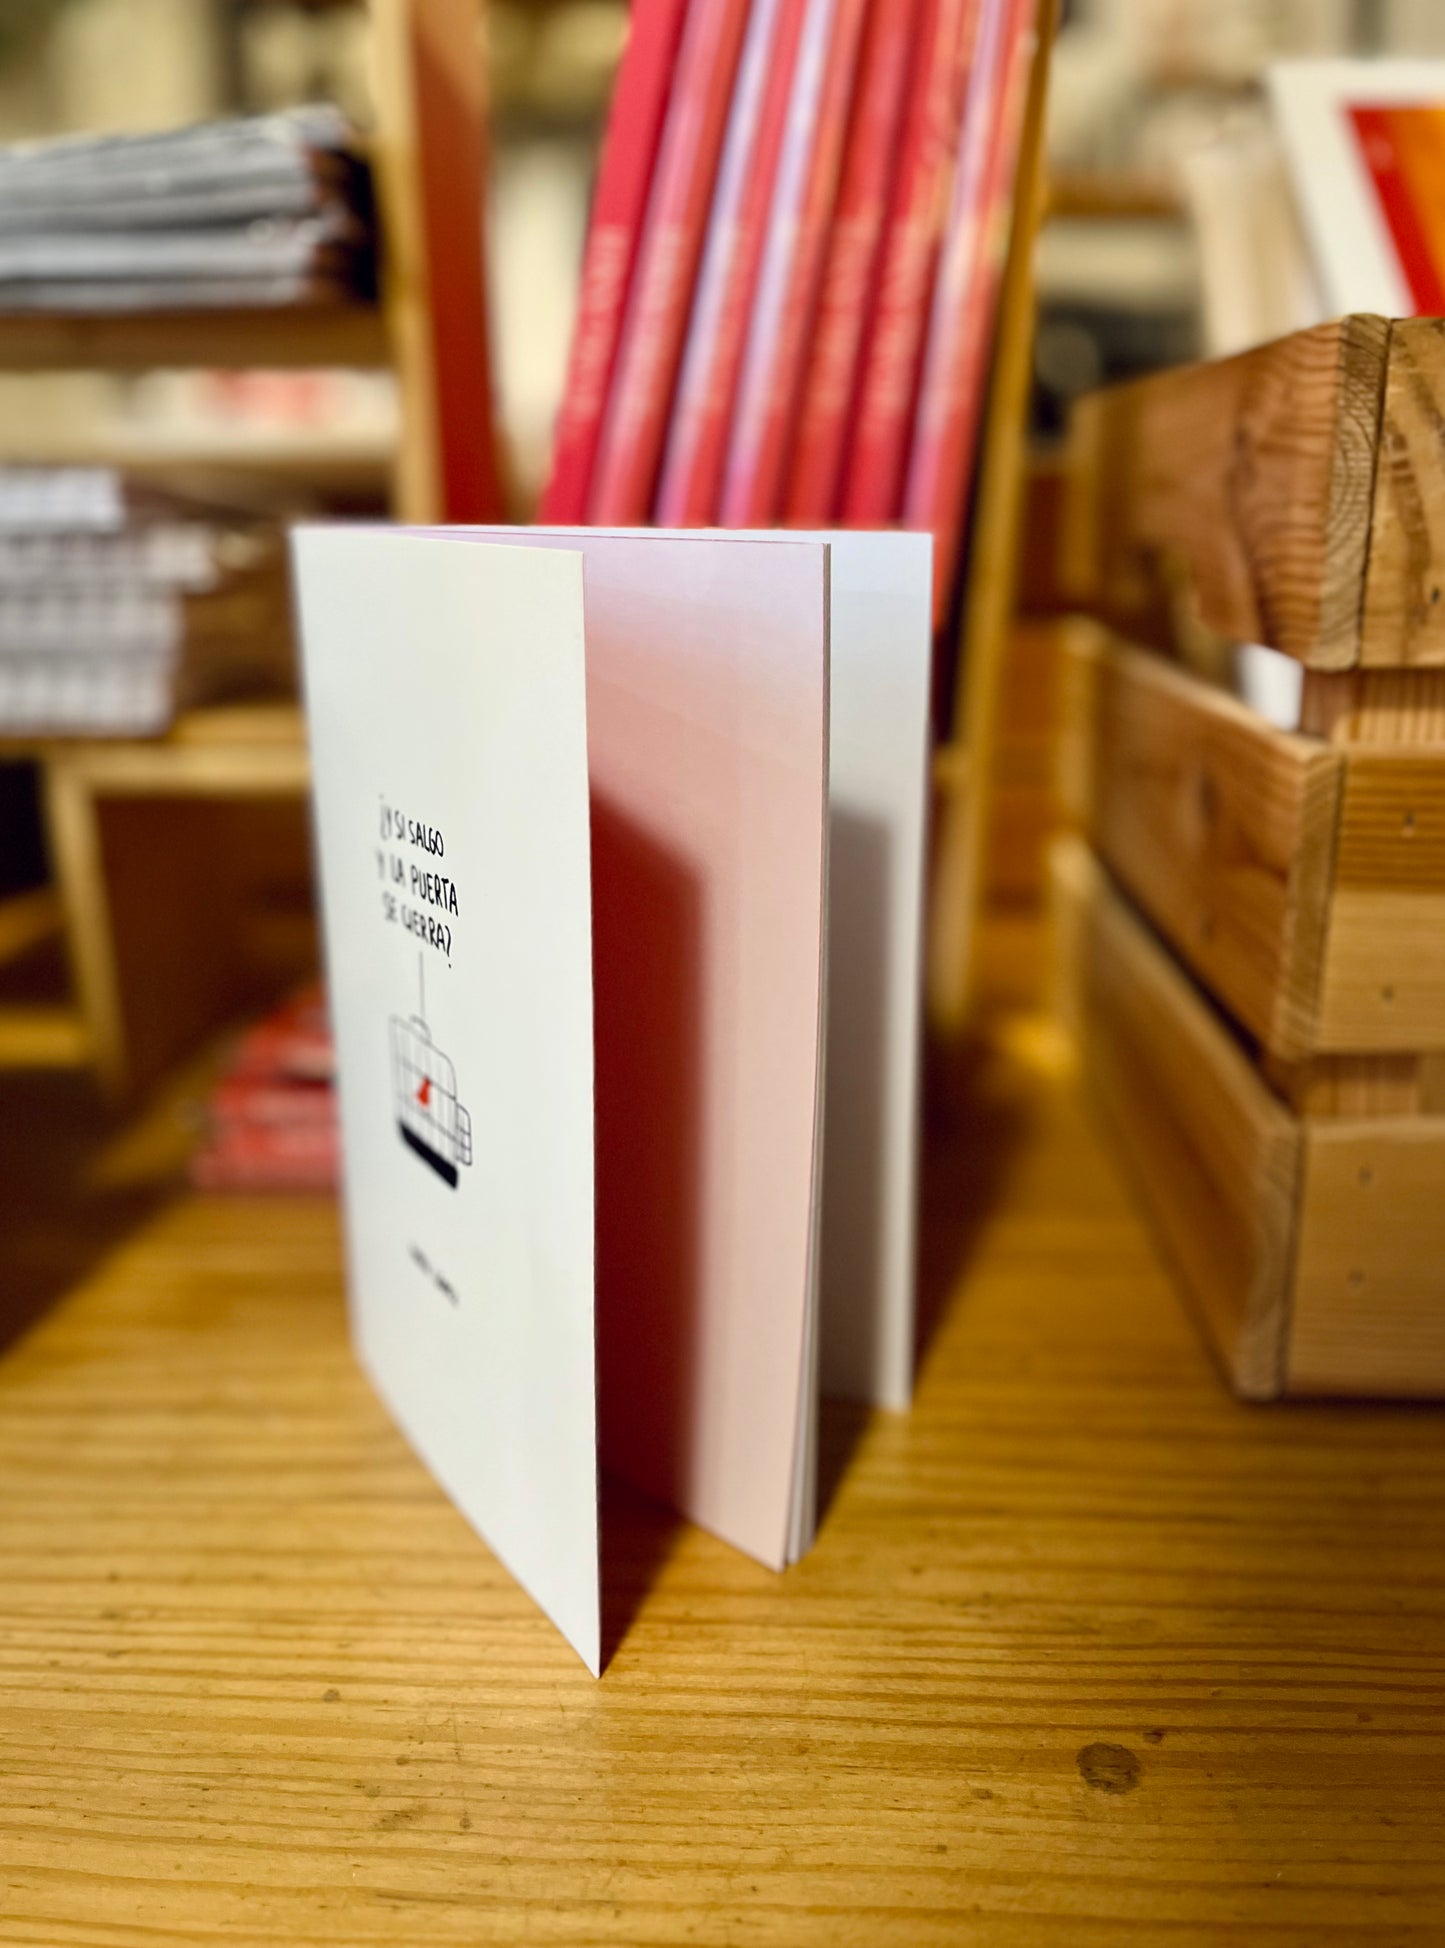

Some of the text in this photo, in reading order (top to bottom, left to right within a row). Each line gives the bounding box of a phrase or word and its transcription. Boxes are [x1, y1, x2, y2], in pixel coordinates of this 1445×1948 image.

[395, 810, 406, 841] SI
[408, 819, 445, 858] SALGO
[375, 849, 459, 917] Y LA PUERTA
[401, 905, 453, 969] CIERRA?
